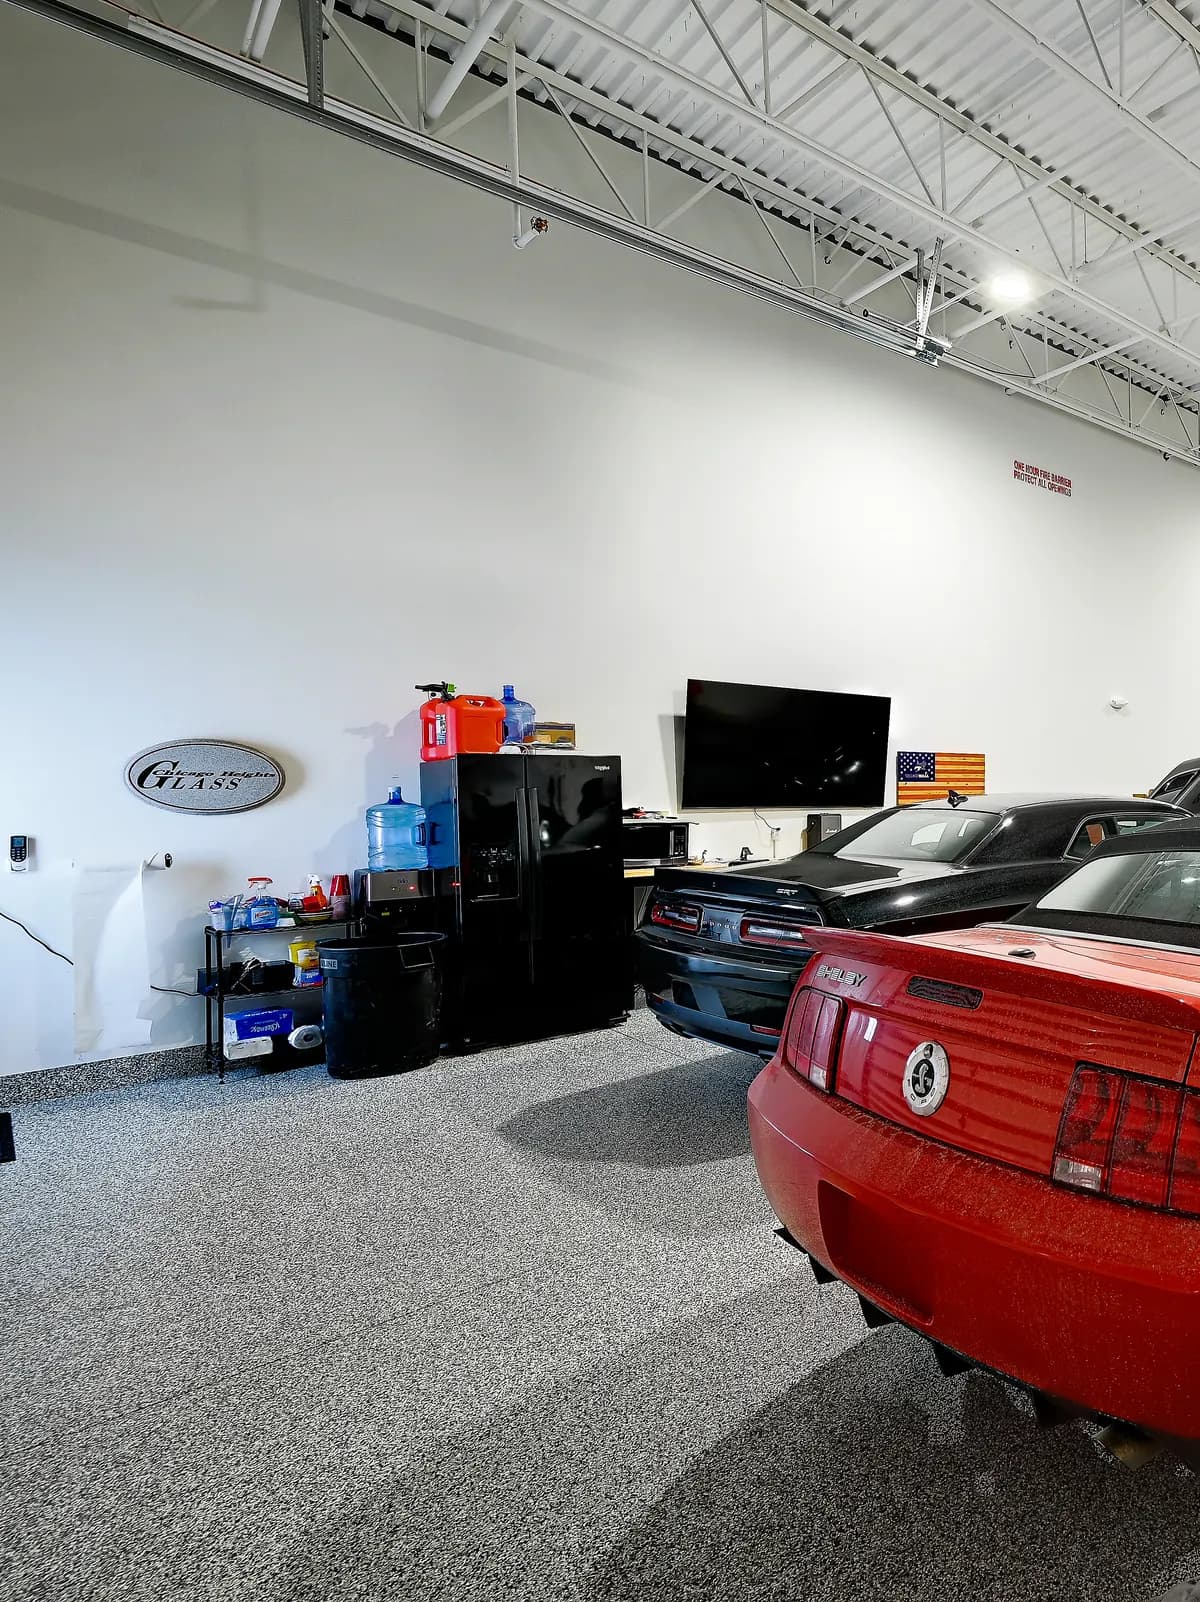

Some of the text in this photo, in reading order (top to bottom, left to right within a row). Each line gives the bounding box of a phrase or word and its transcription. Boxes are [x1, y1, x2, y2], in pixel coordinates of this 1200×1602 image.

[1013, 470, 1072, 497] PROTECT ALL OPENINGS
[1014, 460, 1072, 488] ONE HOUR FIRE BARRIER
[137, 760, 242, 790] GLASS
[220, 771, 276, 779] Heights
[776, 888, 799, 897] SRT
[816, 963, 868, 987] SHELBY
